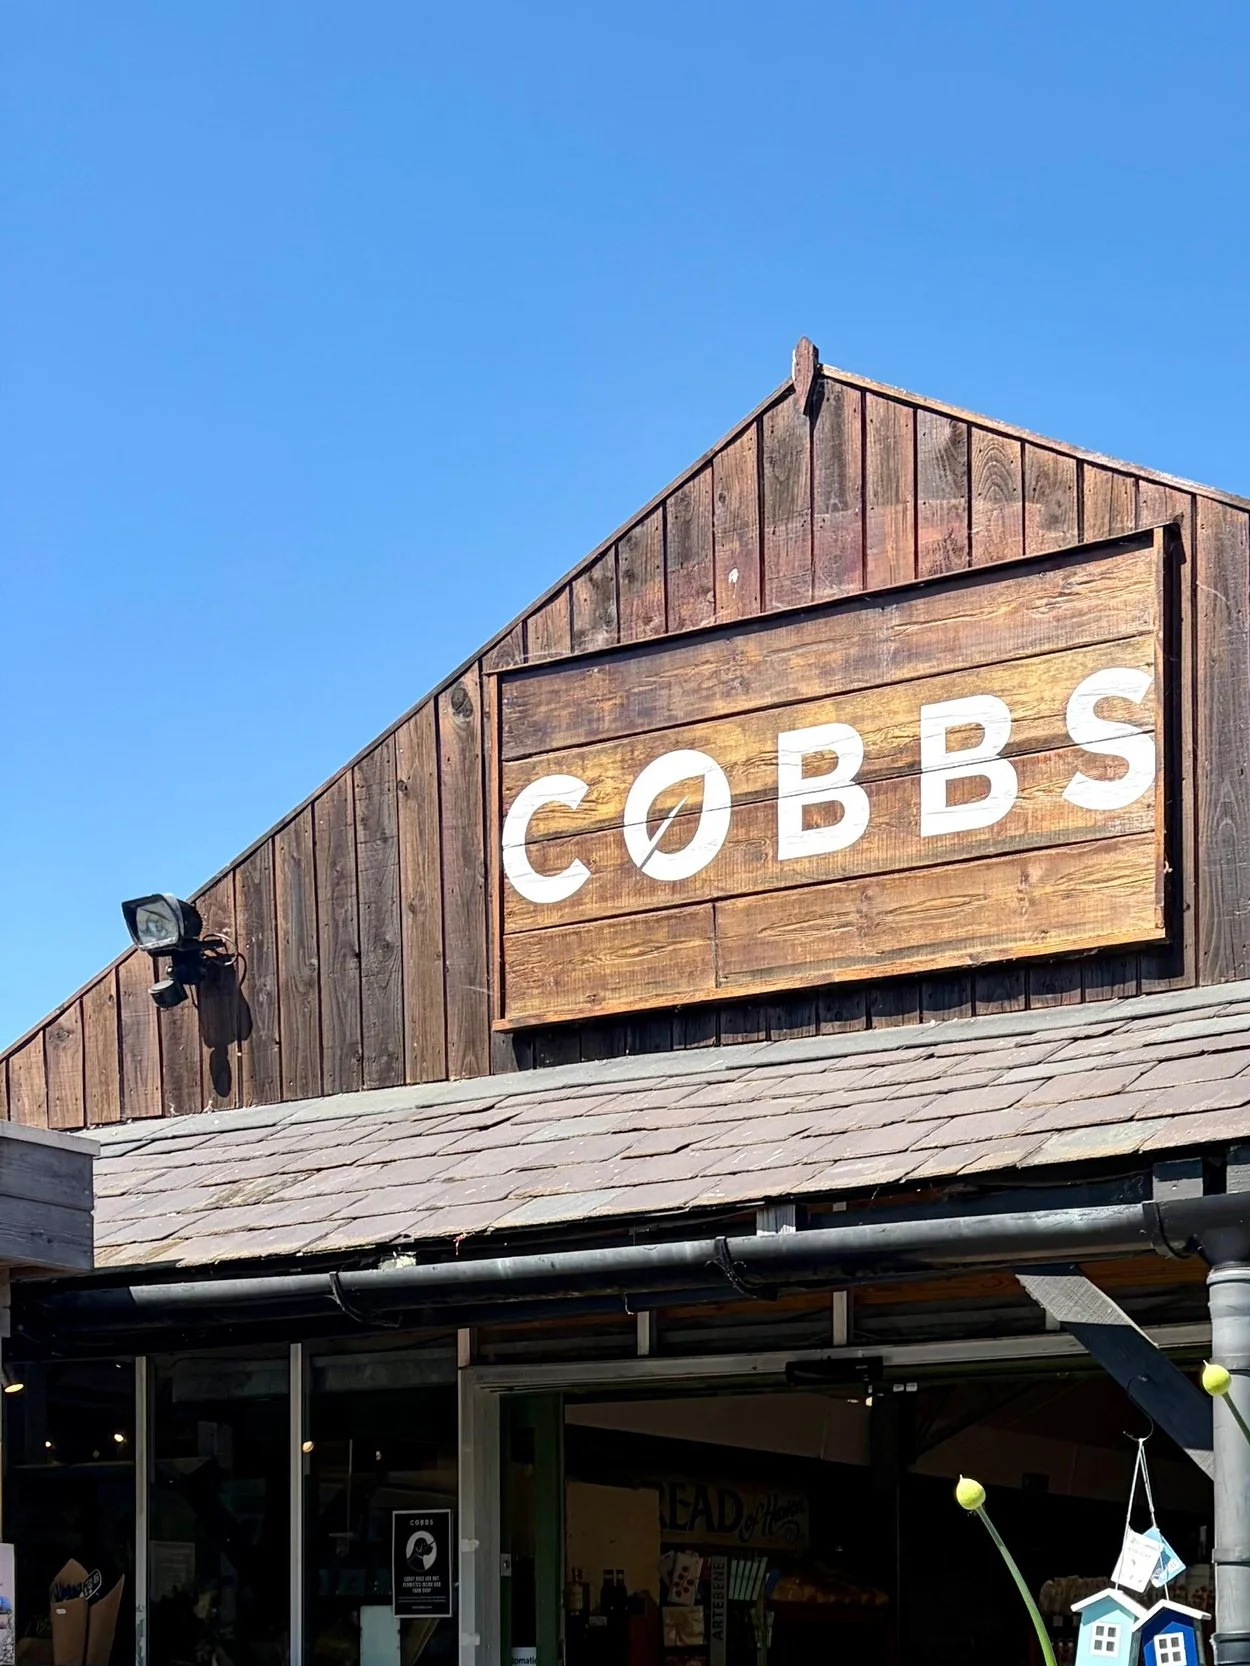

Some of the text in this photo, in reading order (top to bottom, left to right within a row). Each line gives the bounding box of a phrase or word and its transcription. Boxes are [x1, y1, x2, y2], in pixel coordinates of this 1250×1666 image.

[501, 667, 1156, 904] COBBS
[409, 1518, 435, 1526] COBBS
[660, 1482, 743, 1532] EAD
[712, 1561, 725, 1641] ARTEBENE
